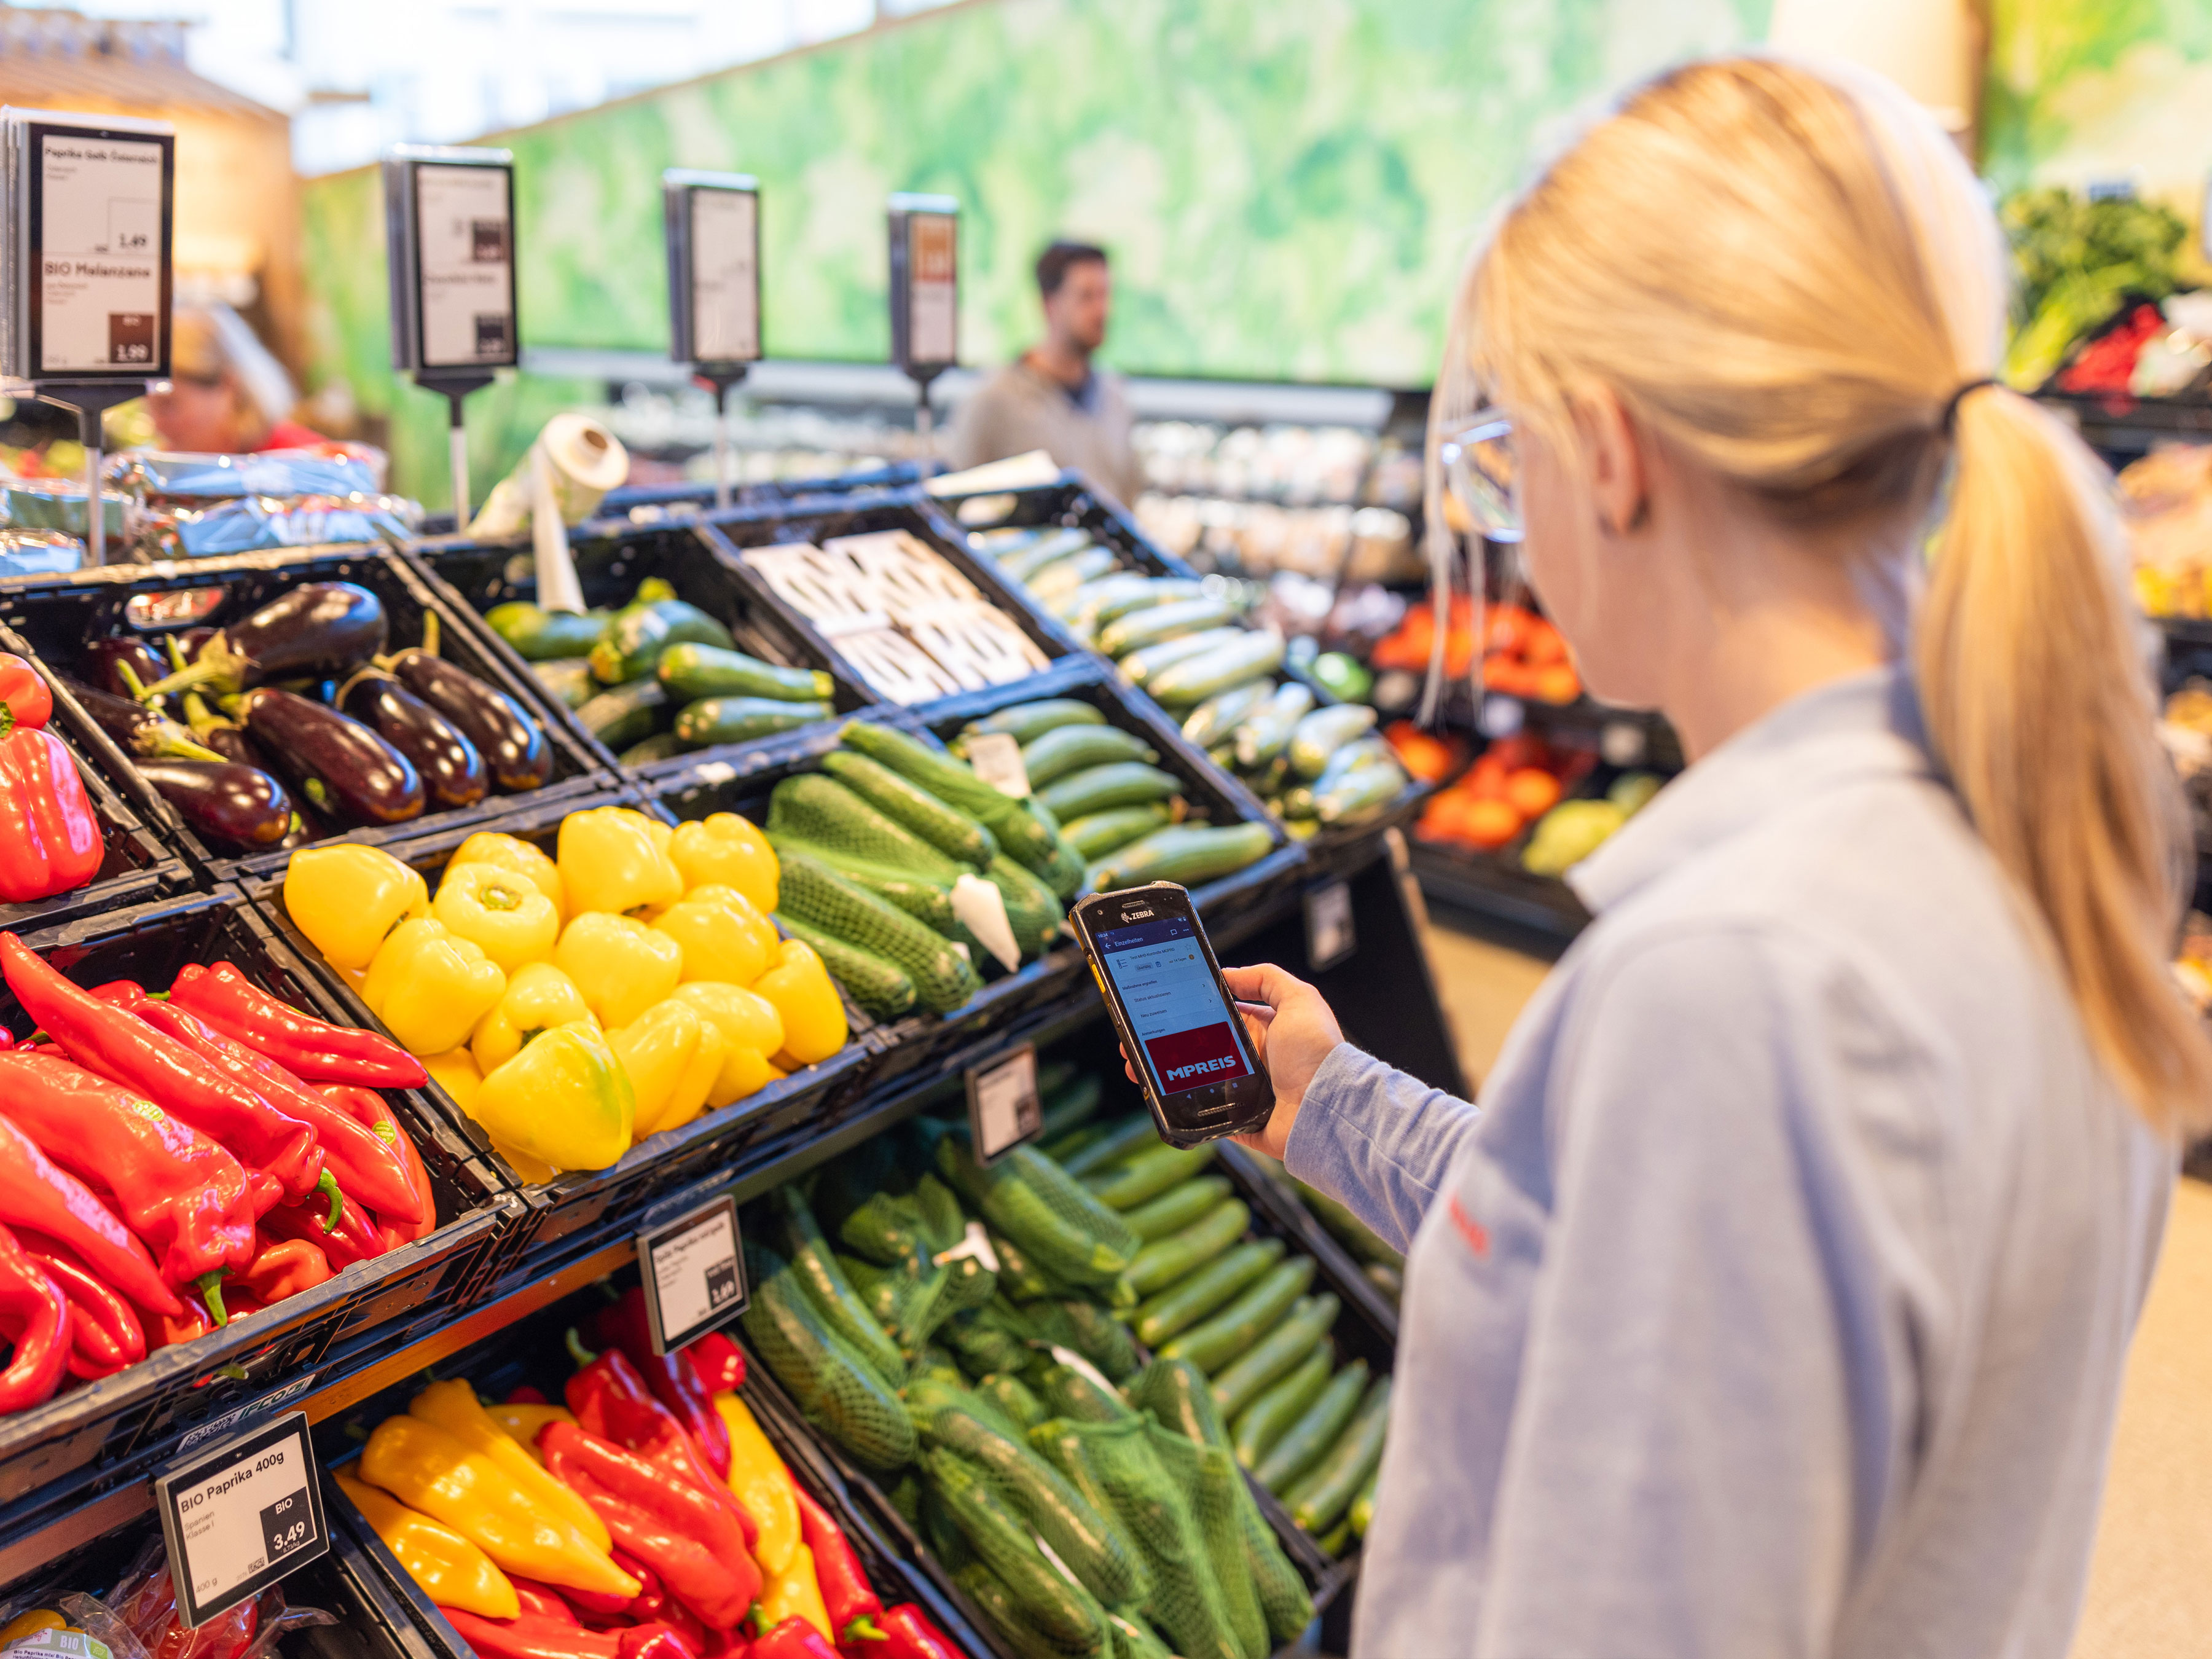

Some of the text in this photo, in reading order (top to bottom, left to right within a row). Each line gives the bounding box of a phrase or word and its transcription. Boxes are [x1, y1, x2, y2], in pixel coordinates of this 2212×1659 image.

[45, 261, 71, 276] BIO
[1131, 909, 1155, 920] ZEBRA
[1115, 937, 1143, 947] Einzelheiten
[1147, 991, 1171, 1000] aktualisieren
[1166, 1055, 1236, 1081] MPREIS
[238, 1390, 286, 1421] IFCO
[181, 1452, 284, 1513] BIO Paprika 400g
[275, 1497, 292, 1515] BIO
[184, 1511, 214, 1531] Spanien
[186, 1524, 210, 1540] Klasse
[273, 1521, 305, 1550] 3.49
[283, 1541, 300, 1553] 8.73/kg
[196, 1577, 218, 1593] 400 g
[60, 1635, 79, 1650] BIO
